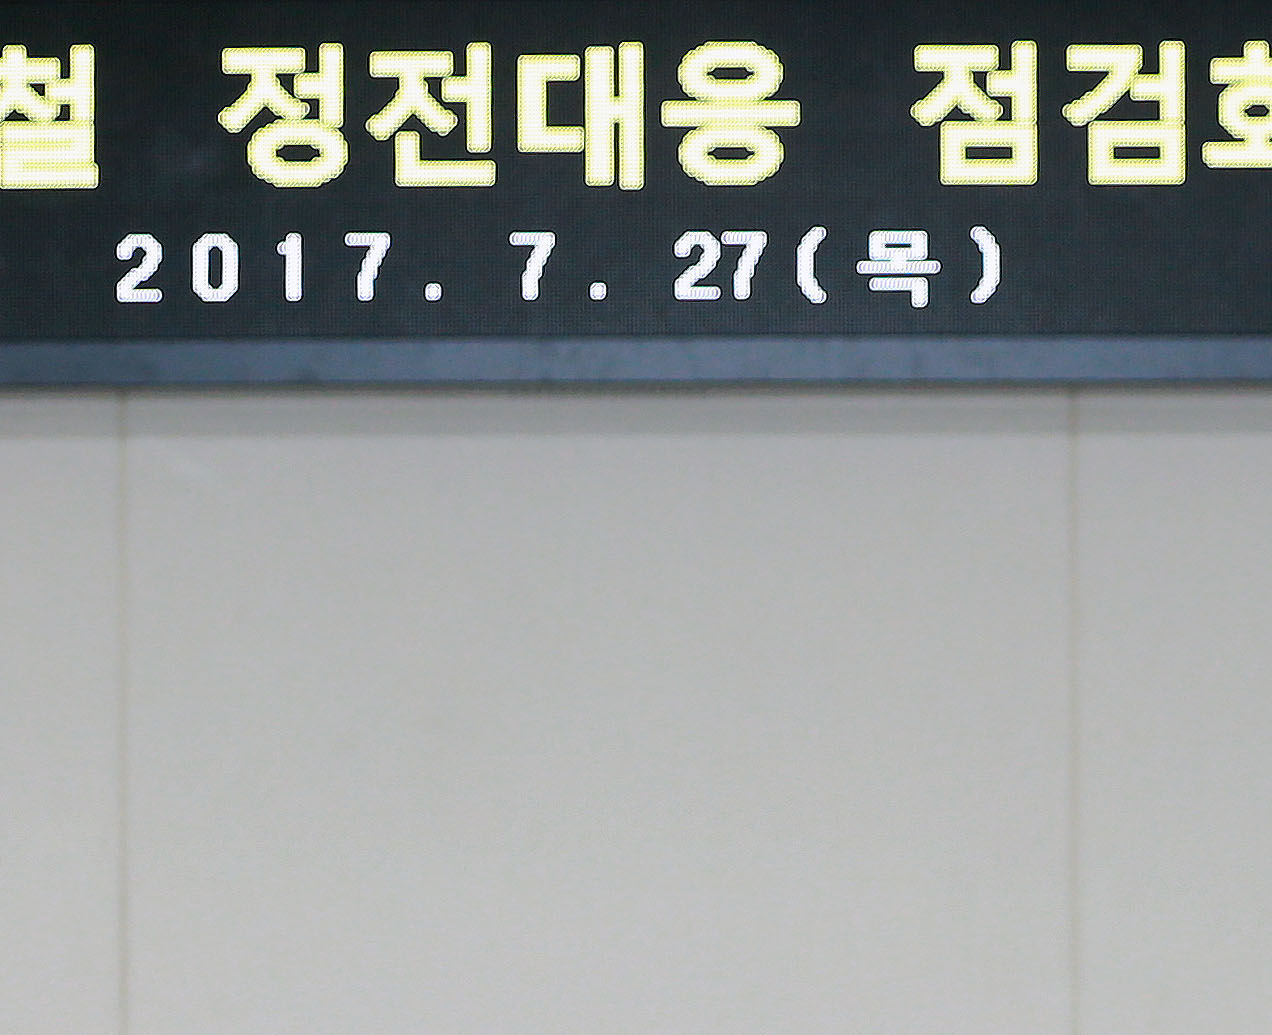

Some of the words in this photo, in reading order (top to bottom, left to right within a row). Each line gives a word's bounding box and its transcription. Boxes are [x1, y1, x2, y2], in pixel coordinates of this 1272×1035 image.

[216, 40, 802, 191] 정전대응
[115, 232, 443, 303] 2017.
[507, 231, 608, 301] 7.
[672, 225, 1002, 308] 27(목)
